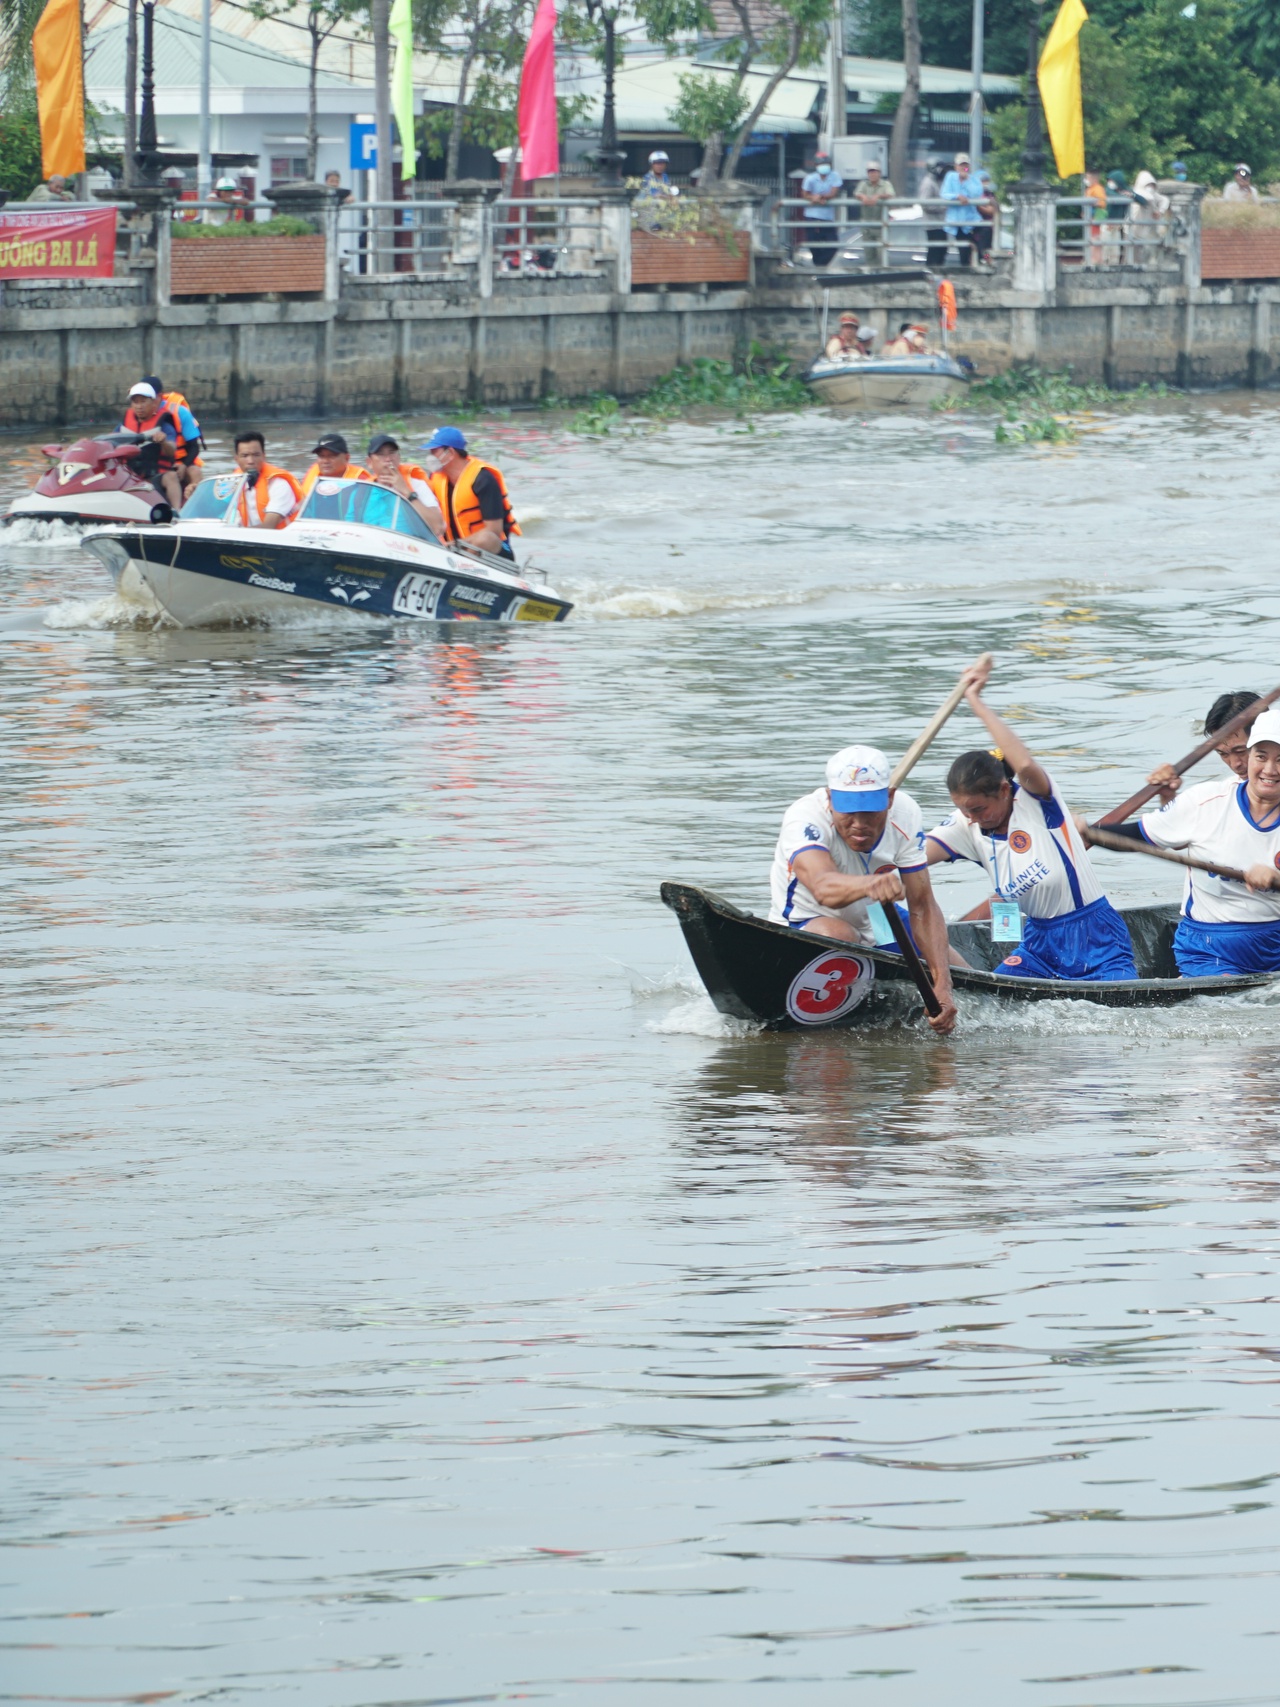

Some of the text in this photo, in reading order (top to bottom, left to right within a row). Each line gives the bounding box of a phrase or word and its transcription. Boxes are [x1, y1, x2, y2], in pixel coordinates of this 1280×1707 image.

[362, 134, 378, 159] P
[49, 240, 72, 267] BA
[75, 231, 98, 267] LÁ
[248, 573, 297, 593] FastBoat
[1005, 859, 1043, 892] ININITE
[796, 956, 863, 1014] 3
